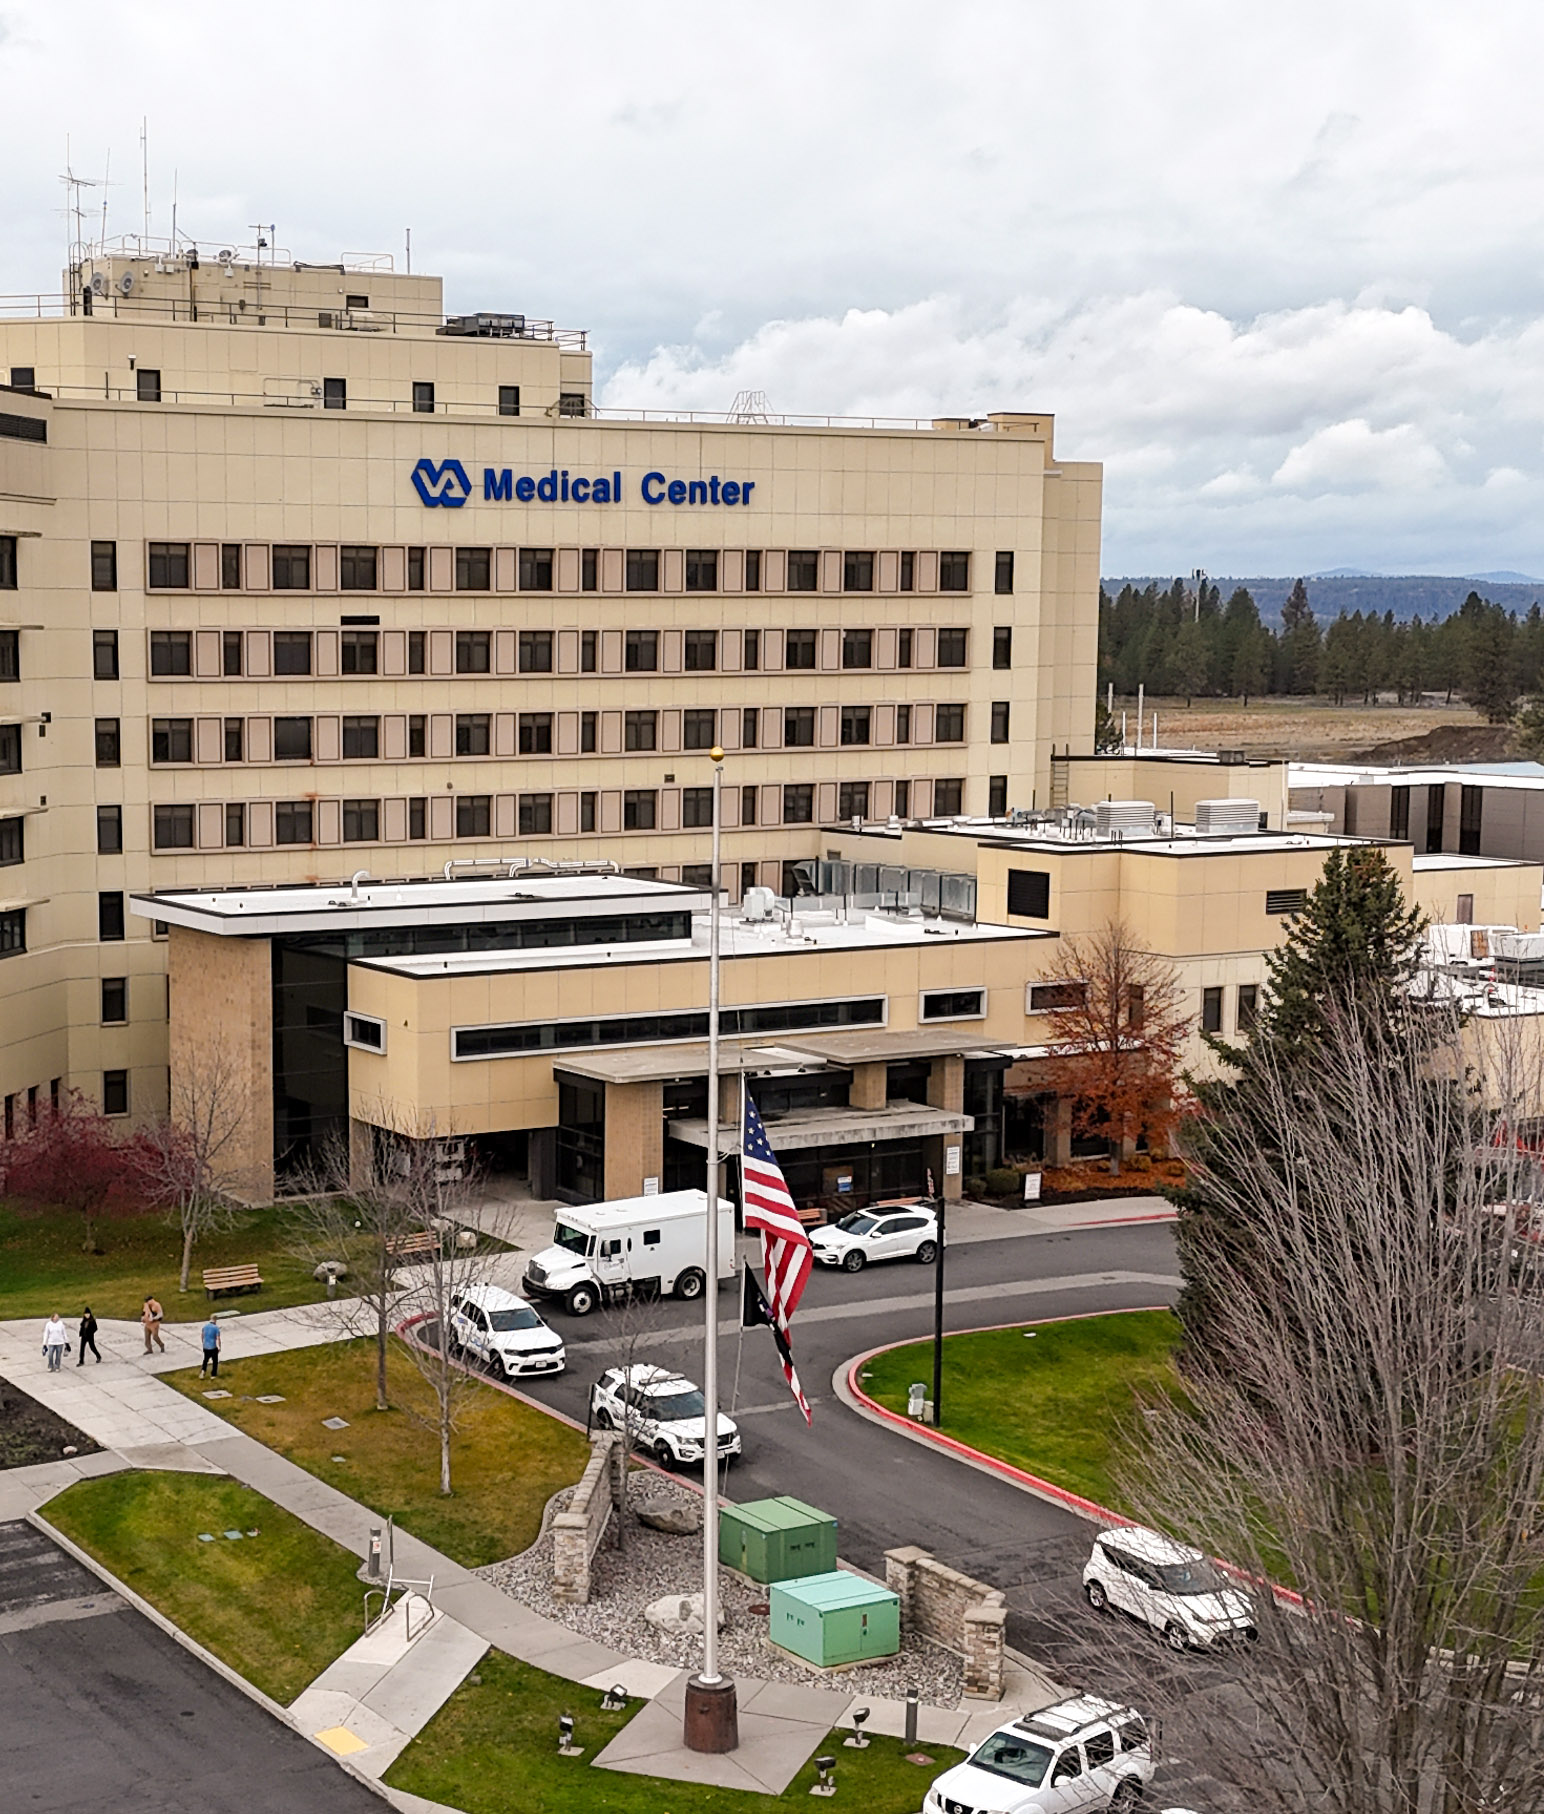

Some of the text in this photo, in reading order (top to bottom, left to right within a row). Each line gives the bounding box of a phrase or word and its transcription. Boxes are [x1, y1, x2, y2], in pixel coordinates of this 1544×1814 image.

[411, 458, 755, 508] VA Medical Center
